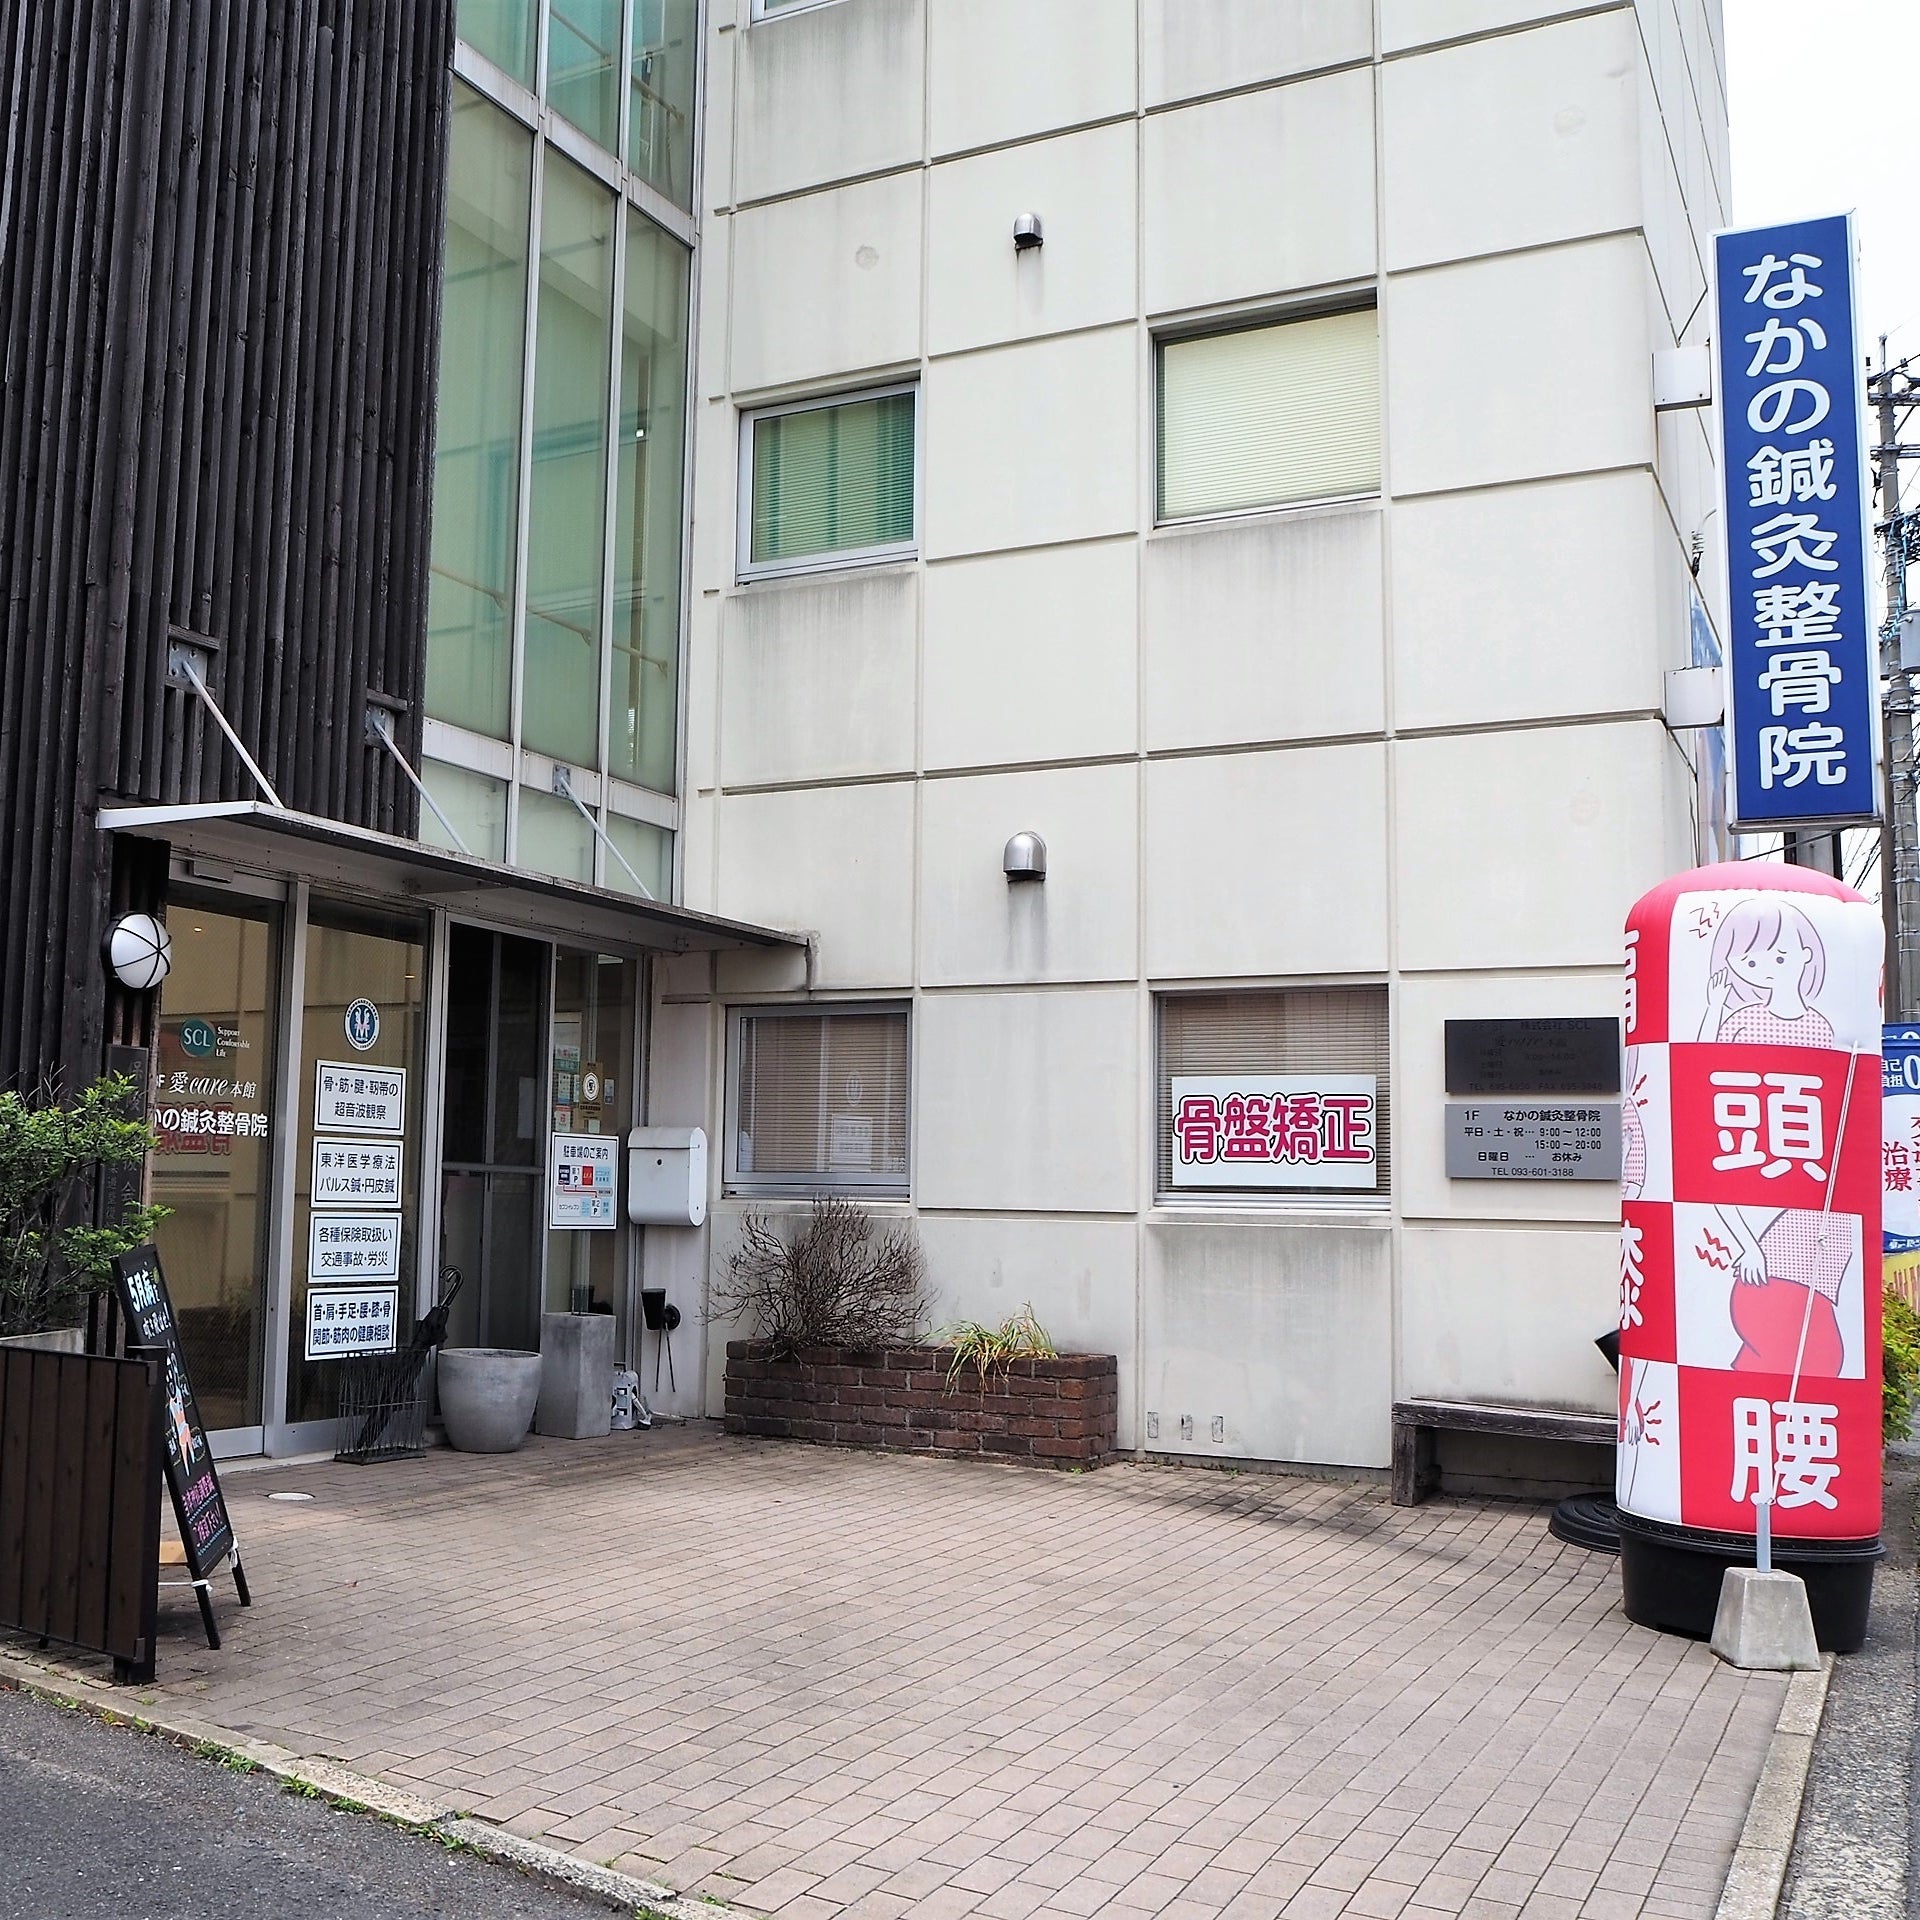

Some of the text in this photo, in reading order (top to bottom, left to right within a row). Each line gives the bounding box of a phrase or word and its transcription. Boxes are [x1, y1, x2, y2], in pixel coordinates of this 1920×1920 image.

[1742, 253, 1848, 791] なかの鍼灸整骨院
[1567, 1021, 1591, 1030] SCL
[183, 1027, 210, 1047] SCL
[334, 1101, 387, 1120] 超音波観察
[1464, 1109, 1601, 1122] 1F なかの鍼灸整骨院
[1174, 1092, 1374, 1165] 骨盤矯正
[1708, 1069, 1829, 1184] 頭
[320, 1152, 396, 1171] 東洋医学療法
[563, 1145, 609, 1160] 駐車場のご案内
[1478, 1151, 1509, 1162] 日曜日
[1551, 1152, 1583, 1163] お休み
[1491, 1168, 1574, 1177] TEL 093-601-3188
[1882, 1141, 1913, 1192] 治療
[319, 1177, 395, 1194] パルス鍼・円皮鍼
[319, 1227, 392, 1244] 各種保険取扱い
[320, 1251, 388, 1268] 交通事故・労災
[1730, 1395, 1840, 1511] 腰
